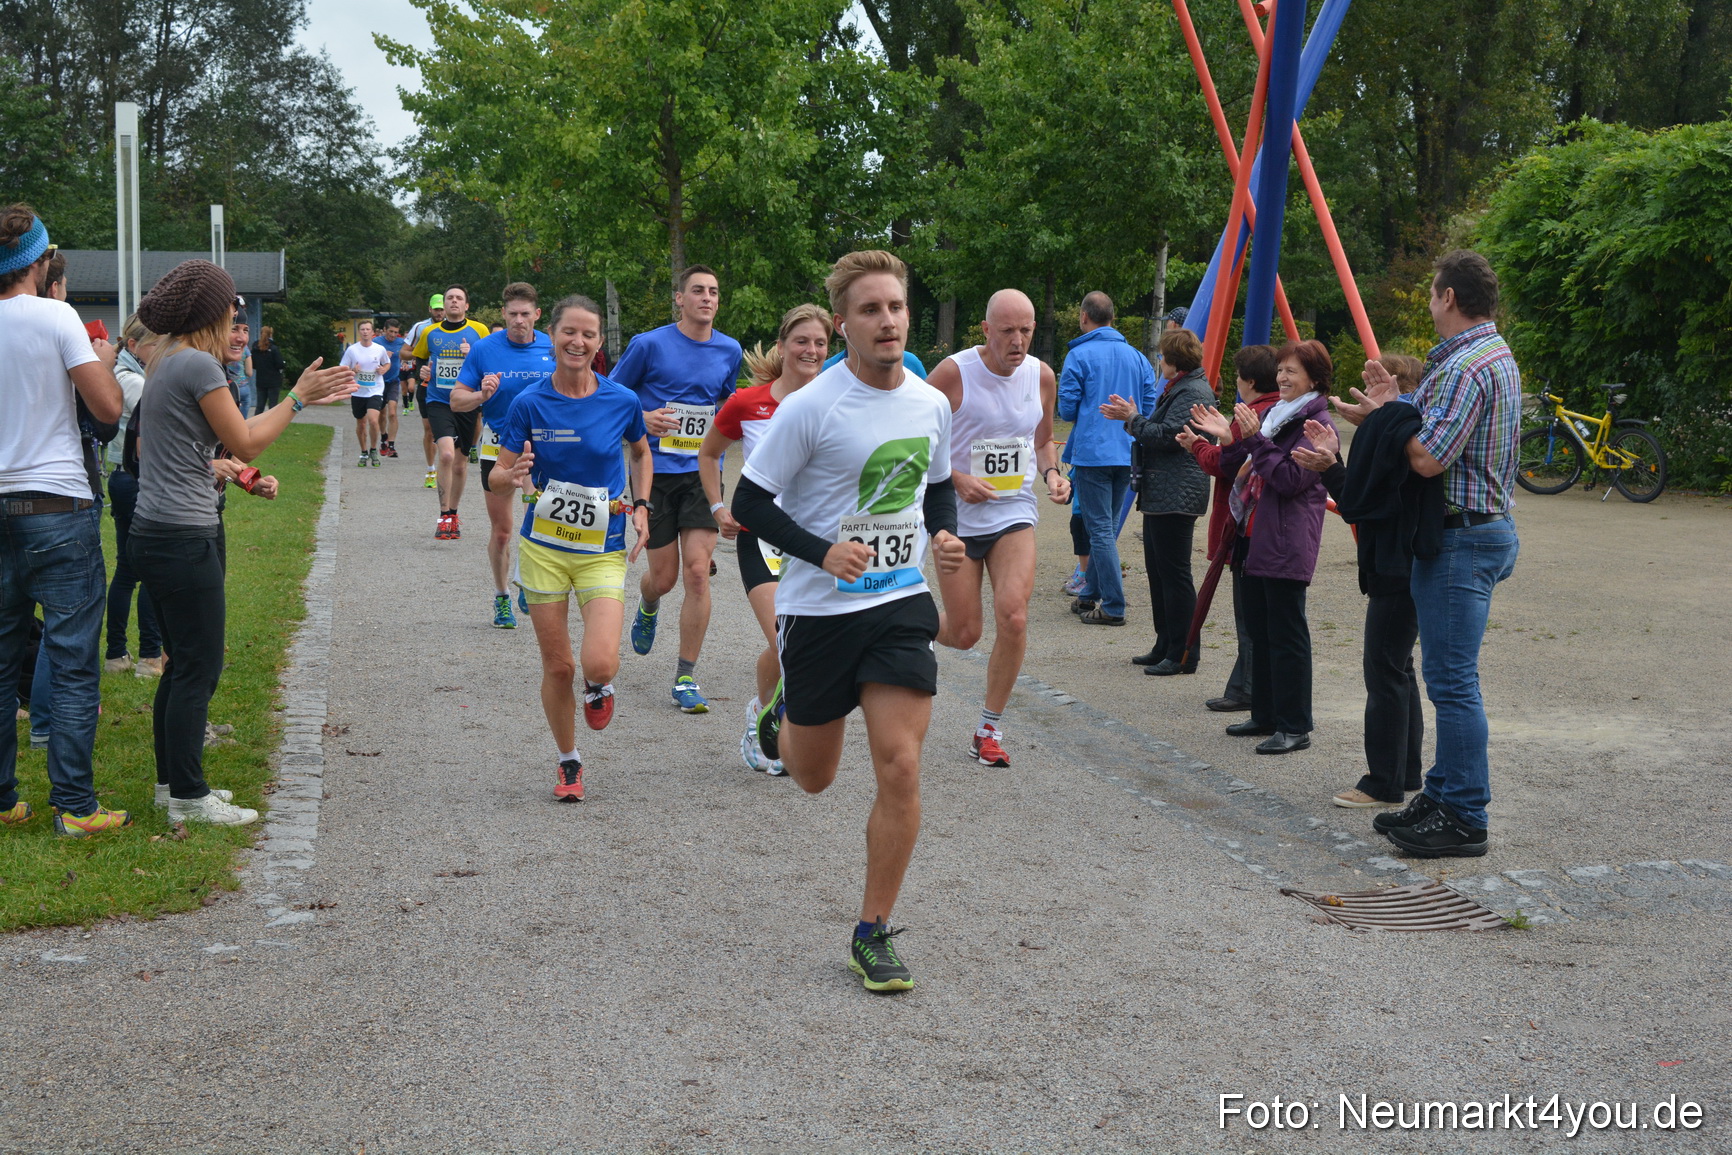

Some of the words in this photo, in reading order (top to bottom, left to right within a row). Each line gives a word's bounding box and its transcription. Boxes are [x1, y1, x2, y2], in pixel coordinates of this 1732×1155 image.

[358, 373, 376, 381] 3332
[672, 439, 701, 448] Matthias
[985, 451, 1019, 475] 651
[549, 497, 596, 527] 235
[556, 526, 582, 542] Birgit
[841, 523, 871, 532] PARTL
[872, 522, 912, 531] Neumarkt
[849, 533, 914, 567] 135
[864, 574, 899, 590] Daniel
